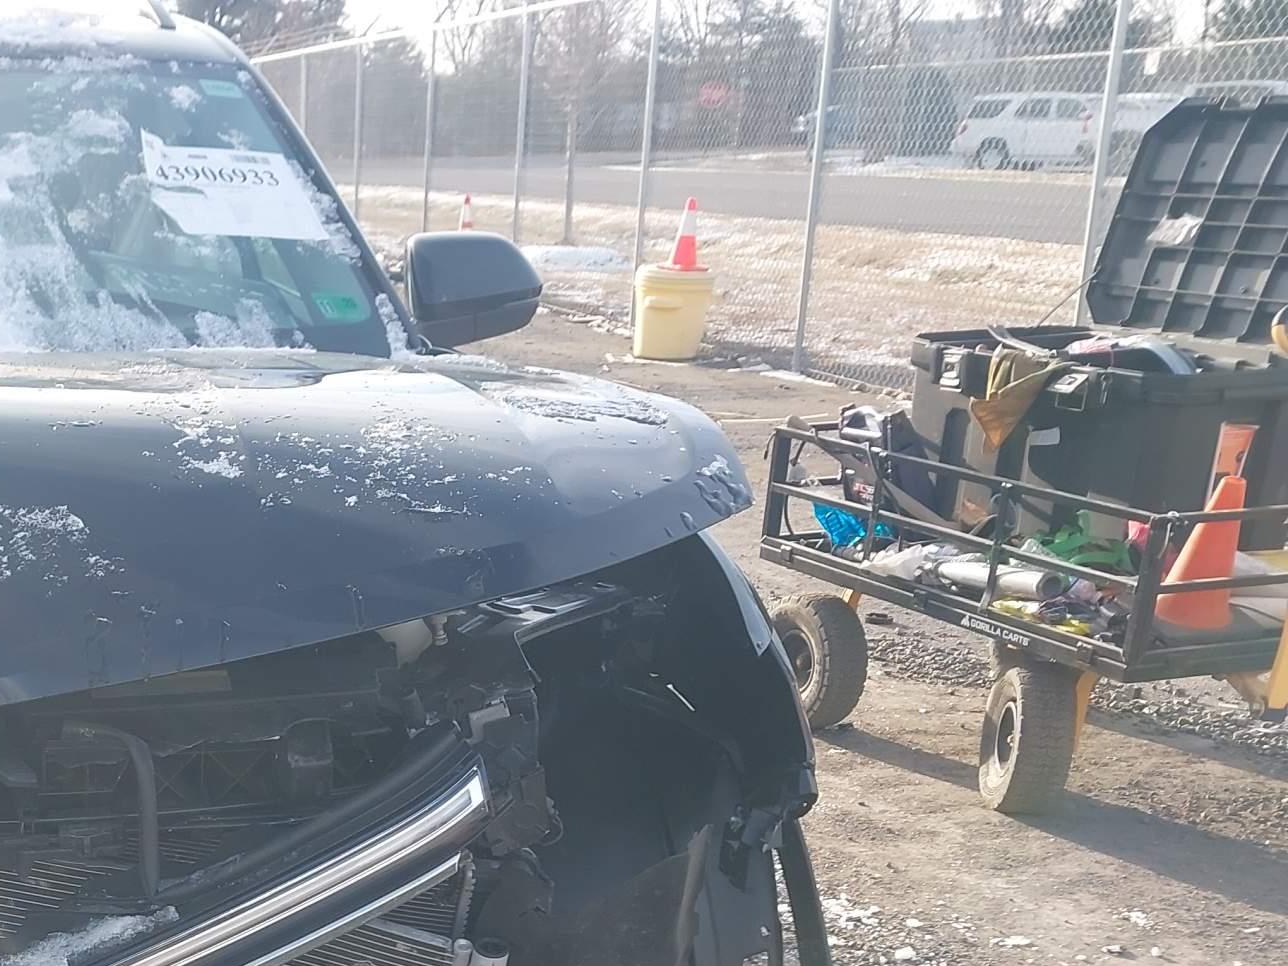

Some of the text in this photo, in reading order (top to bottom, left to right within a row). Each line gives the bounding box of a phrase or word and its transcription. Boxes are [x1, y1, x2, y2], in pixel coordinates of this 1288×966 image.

[155, 165, 279, 186] 43906933
[970, 618, 1029, 647] GORILLA CARTS
